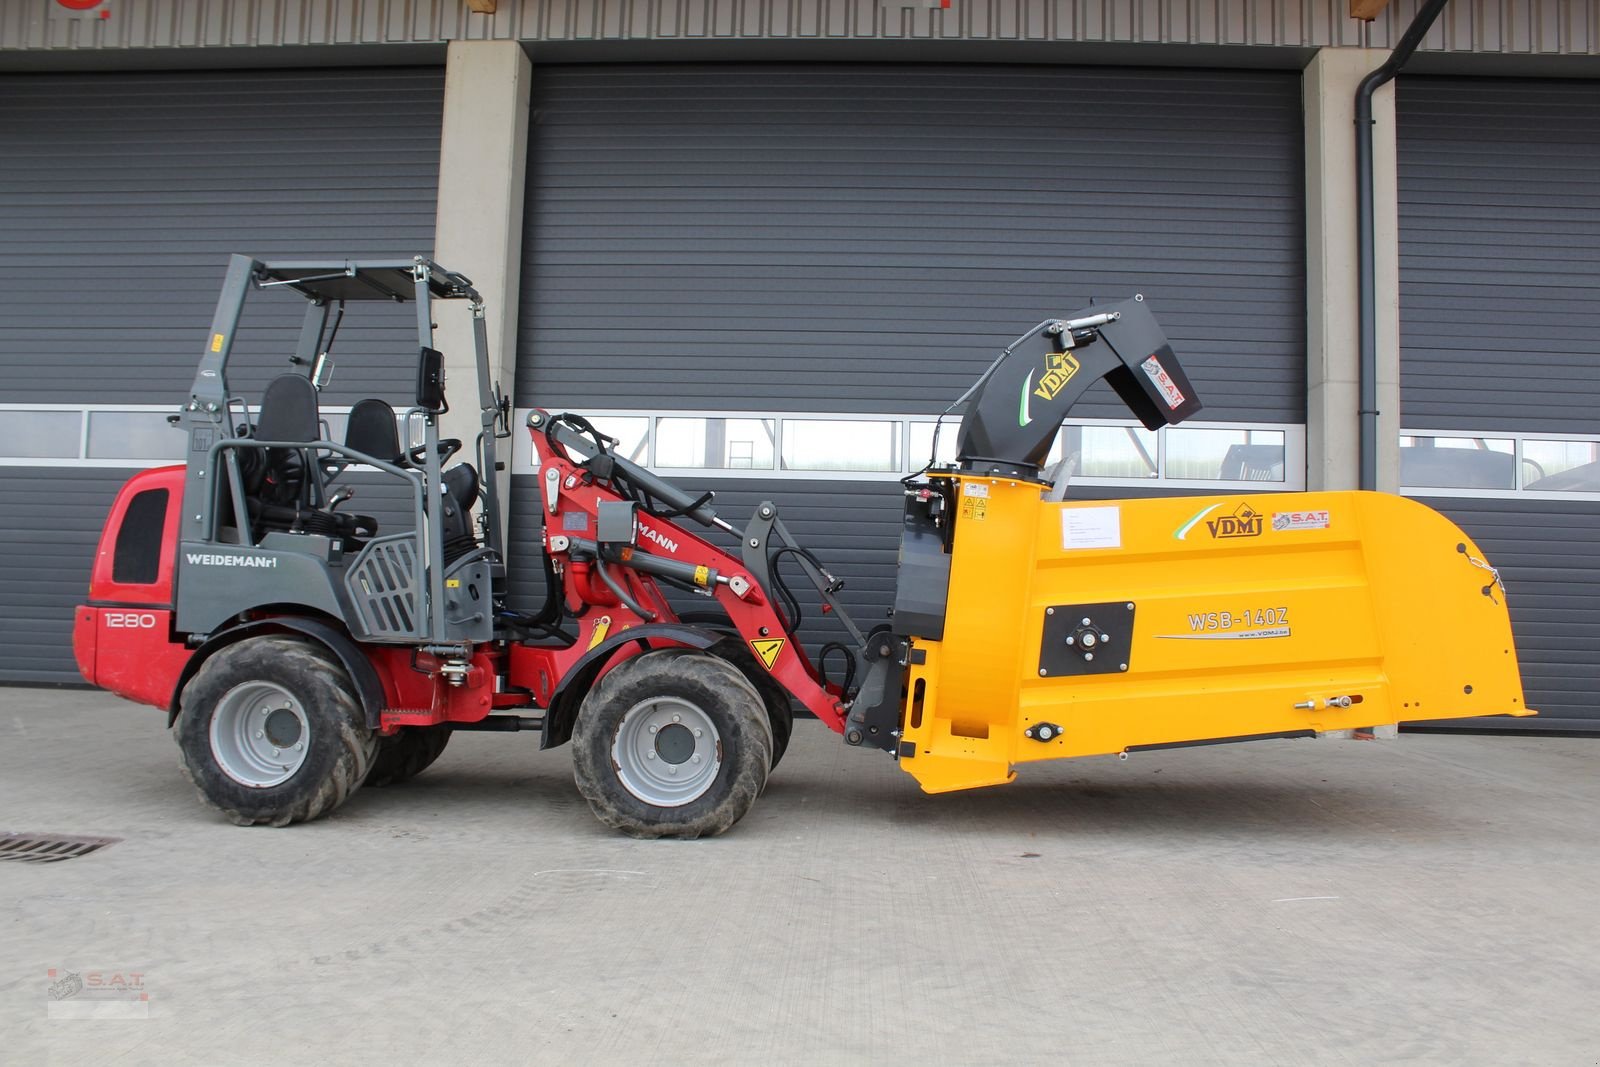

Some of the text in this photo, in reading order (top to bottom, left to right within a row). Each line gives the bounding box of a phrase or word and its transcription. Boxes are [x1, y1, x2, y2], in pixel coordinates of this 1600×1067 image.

[1034, 350, 1080, 400] VDMJ
[1206, 514, 1263, 539] VDMJ
[1291, 512, 1328, 523] S.A.T.
[638, 521, 679, 553] MANN
[104, 613, 156, 628] 1280
[1188, 607, 1288, 632] WSB-140Z
